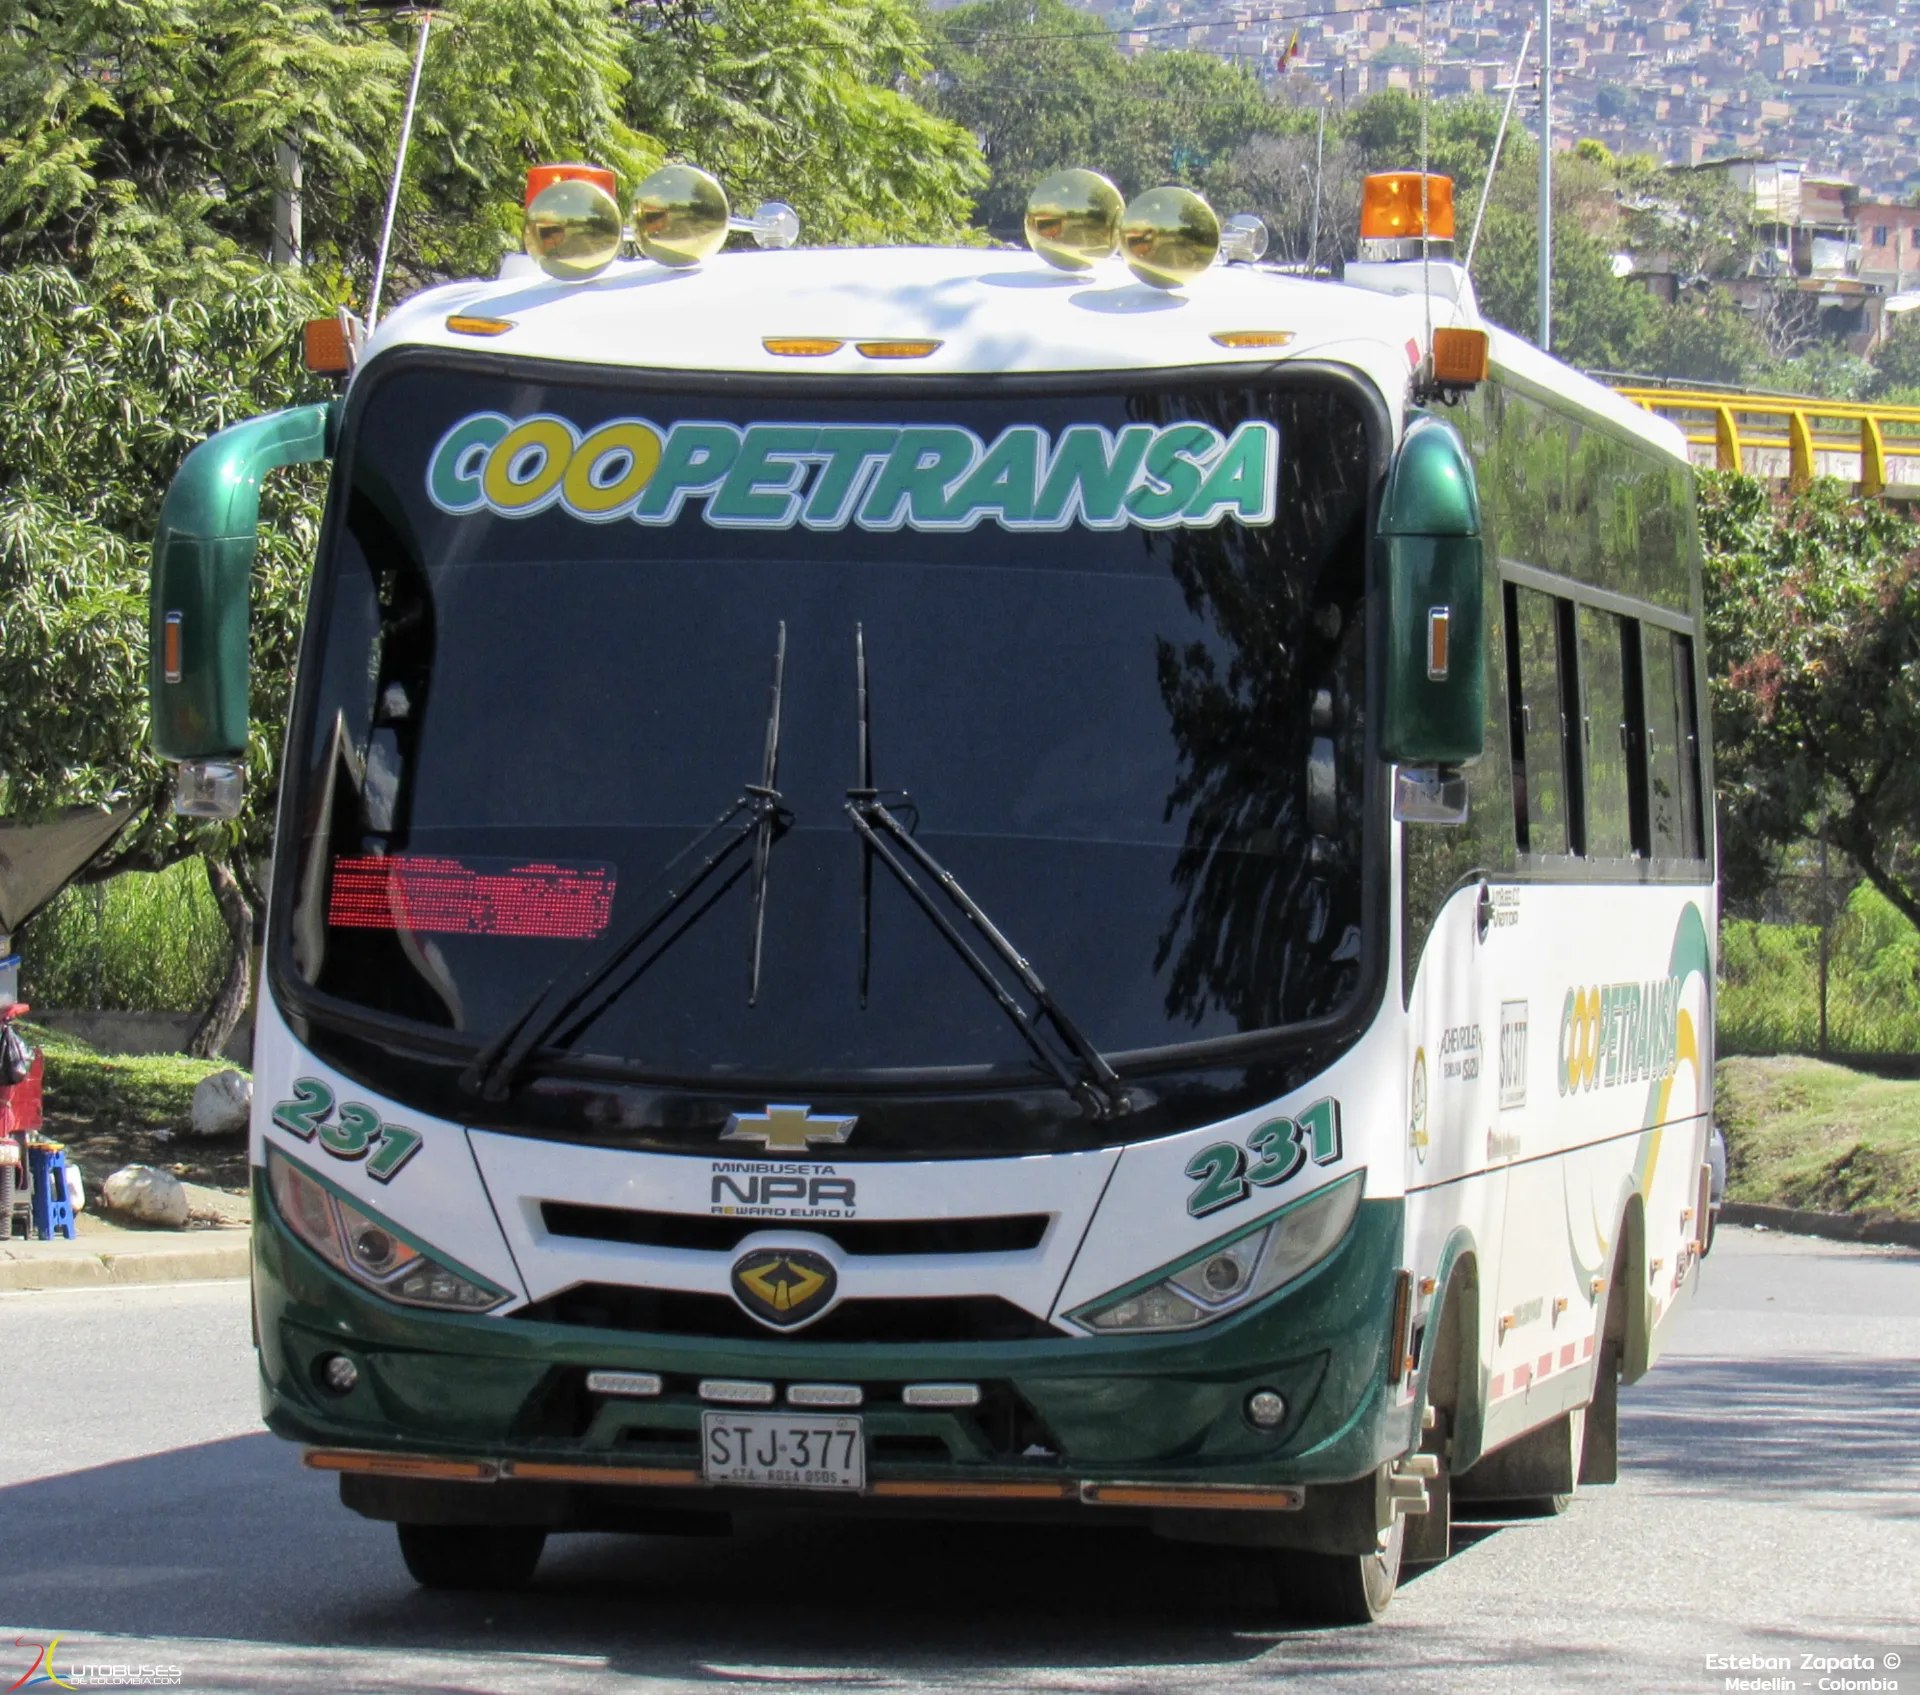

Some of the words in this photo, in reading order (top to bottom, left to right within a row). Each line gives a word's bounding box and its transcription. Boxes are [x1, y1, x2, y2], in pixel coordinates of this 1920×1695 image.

[425, 411, 1279, 531] COOPETRANSA
[1558, 975, 1680, 1098] COOPETRANSA
[272, 1076, 424, 1186] 231
[711, 1162, 836, 1175] MINIBUSETA
[1185, 1095, 1343, 1219] 231
[711, 1175, 856, 1207] NPR
[711, 1206, 786, 1217] REWARD
[790, 1208, 841, 1218] EURO
